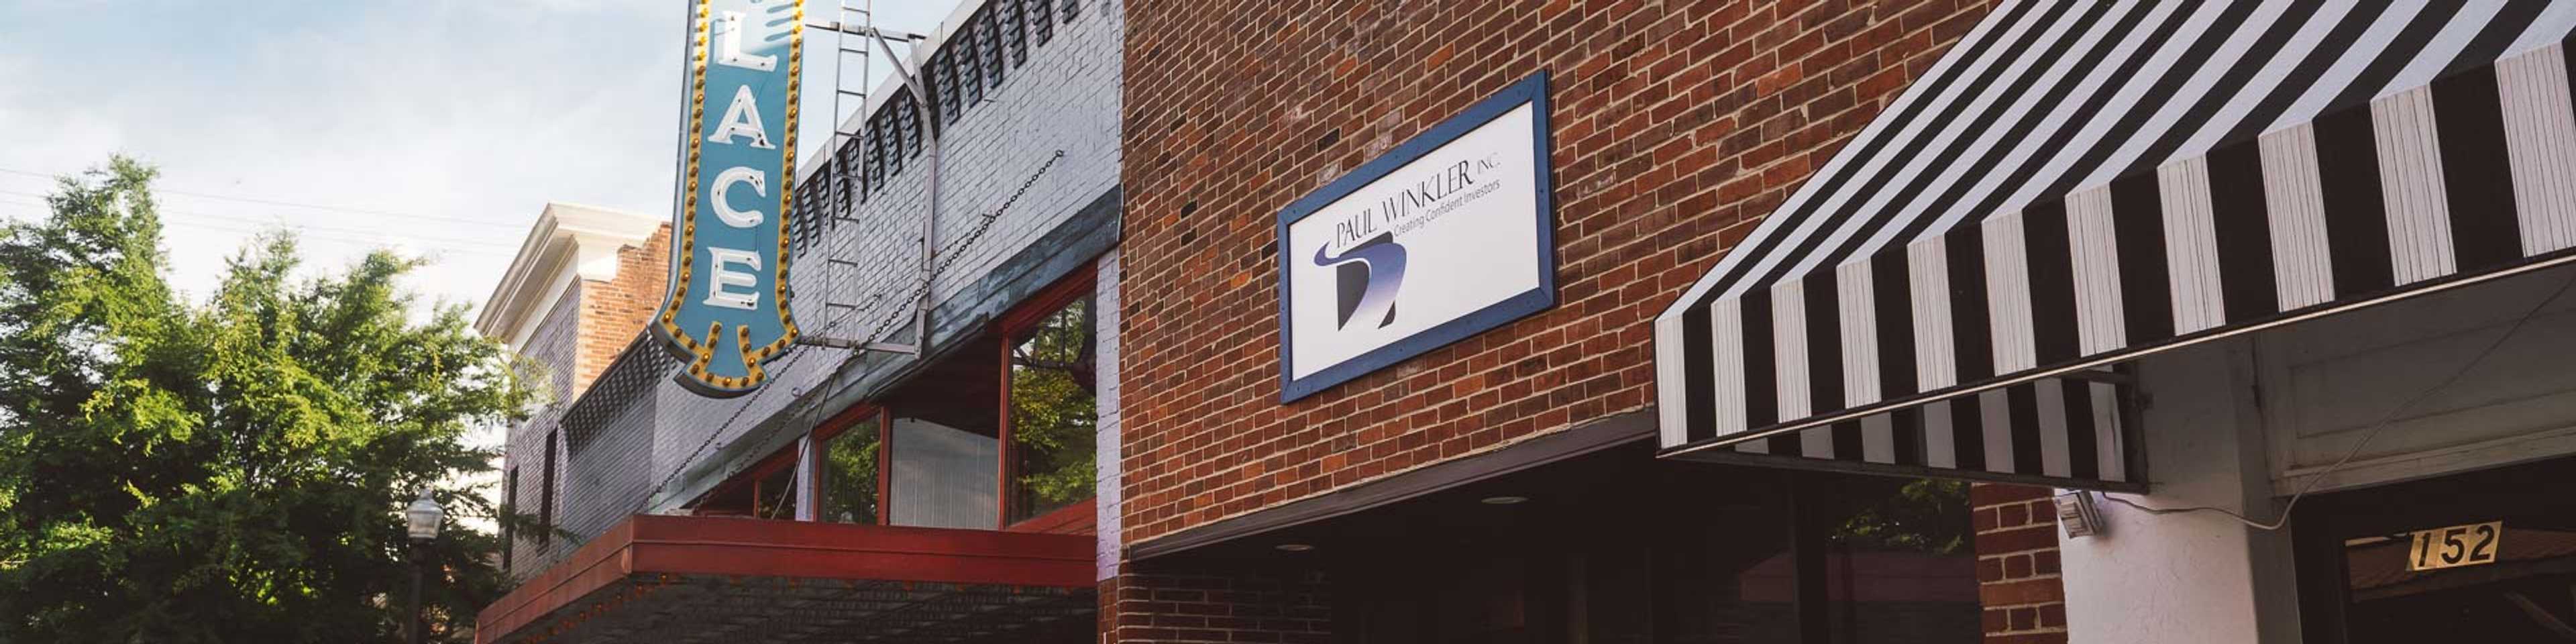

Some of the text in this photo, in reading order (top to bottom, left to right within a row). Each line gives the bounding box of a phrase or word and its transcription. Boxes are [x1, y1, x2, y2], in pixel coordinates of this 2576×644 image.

[1336, 208, 1377, 248] PAUL
[1382, 159, 1474, 223] WINKLER
[1393, 178, 1501, 237] Creating Confident Investors
[2418, 525, 2495, 568] 152
